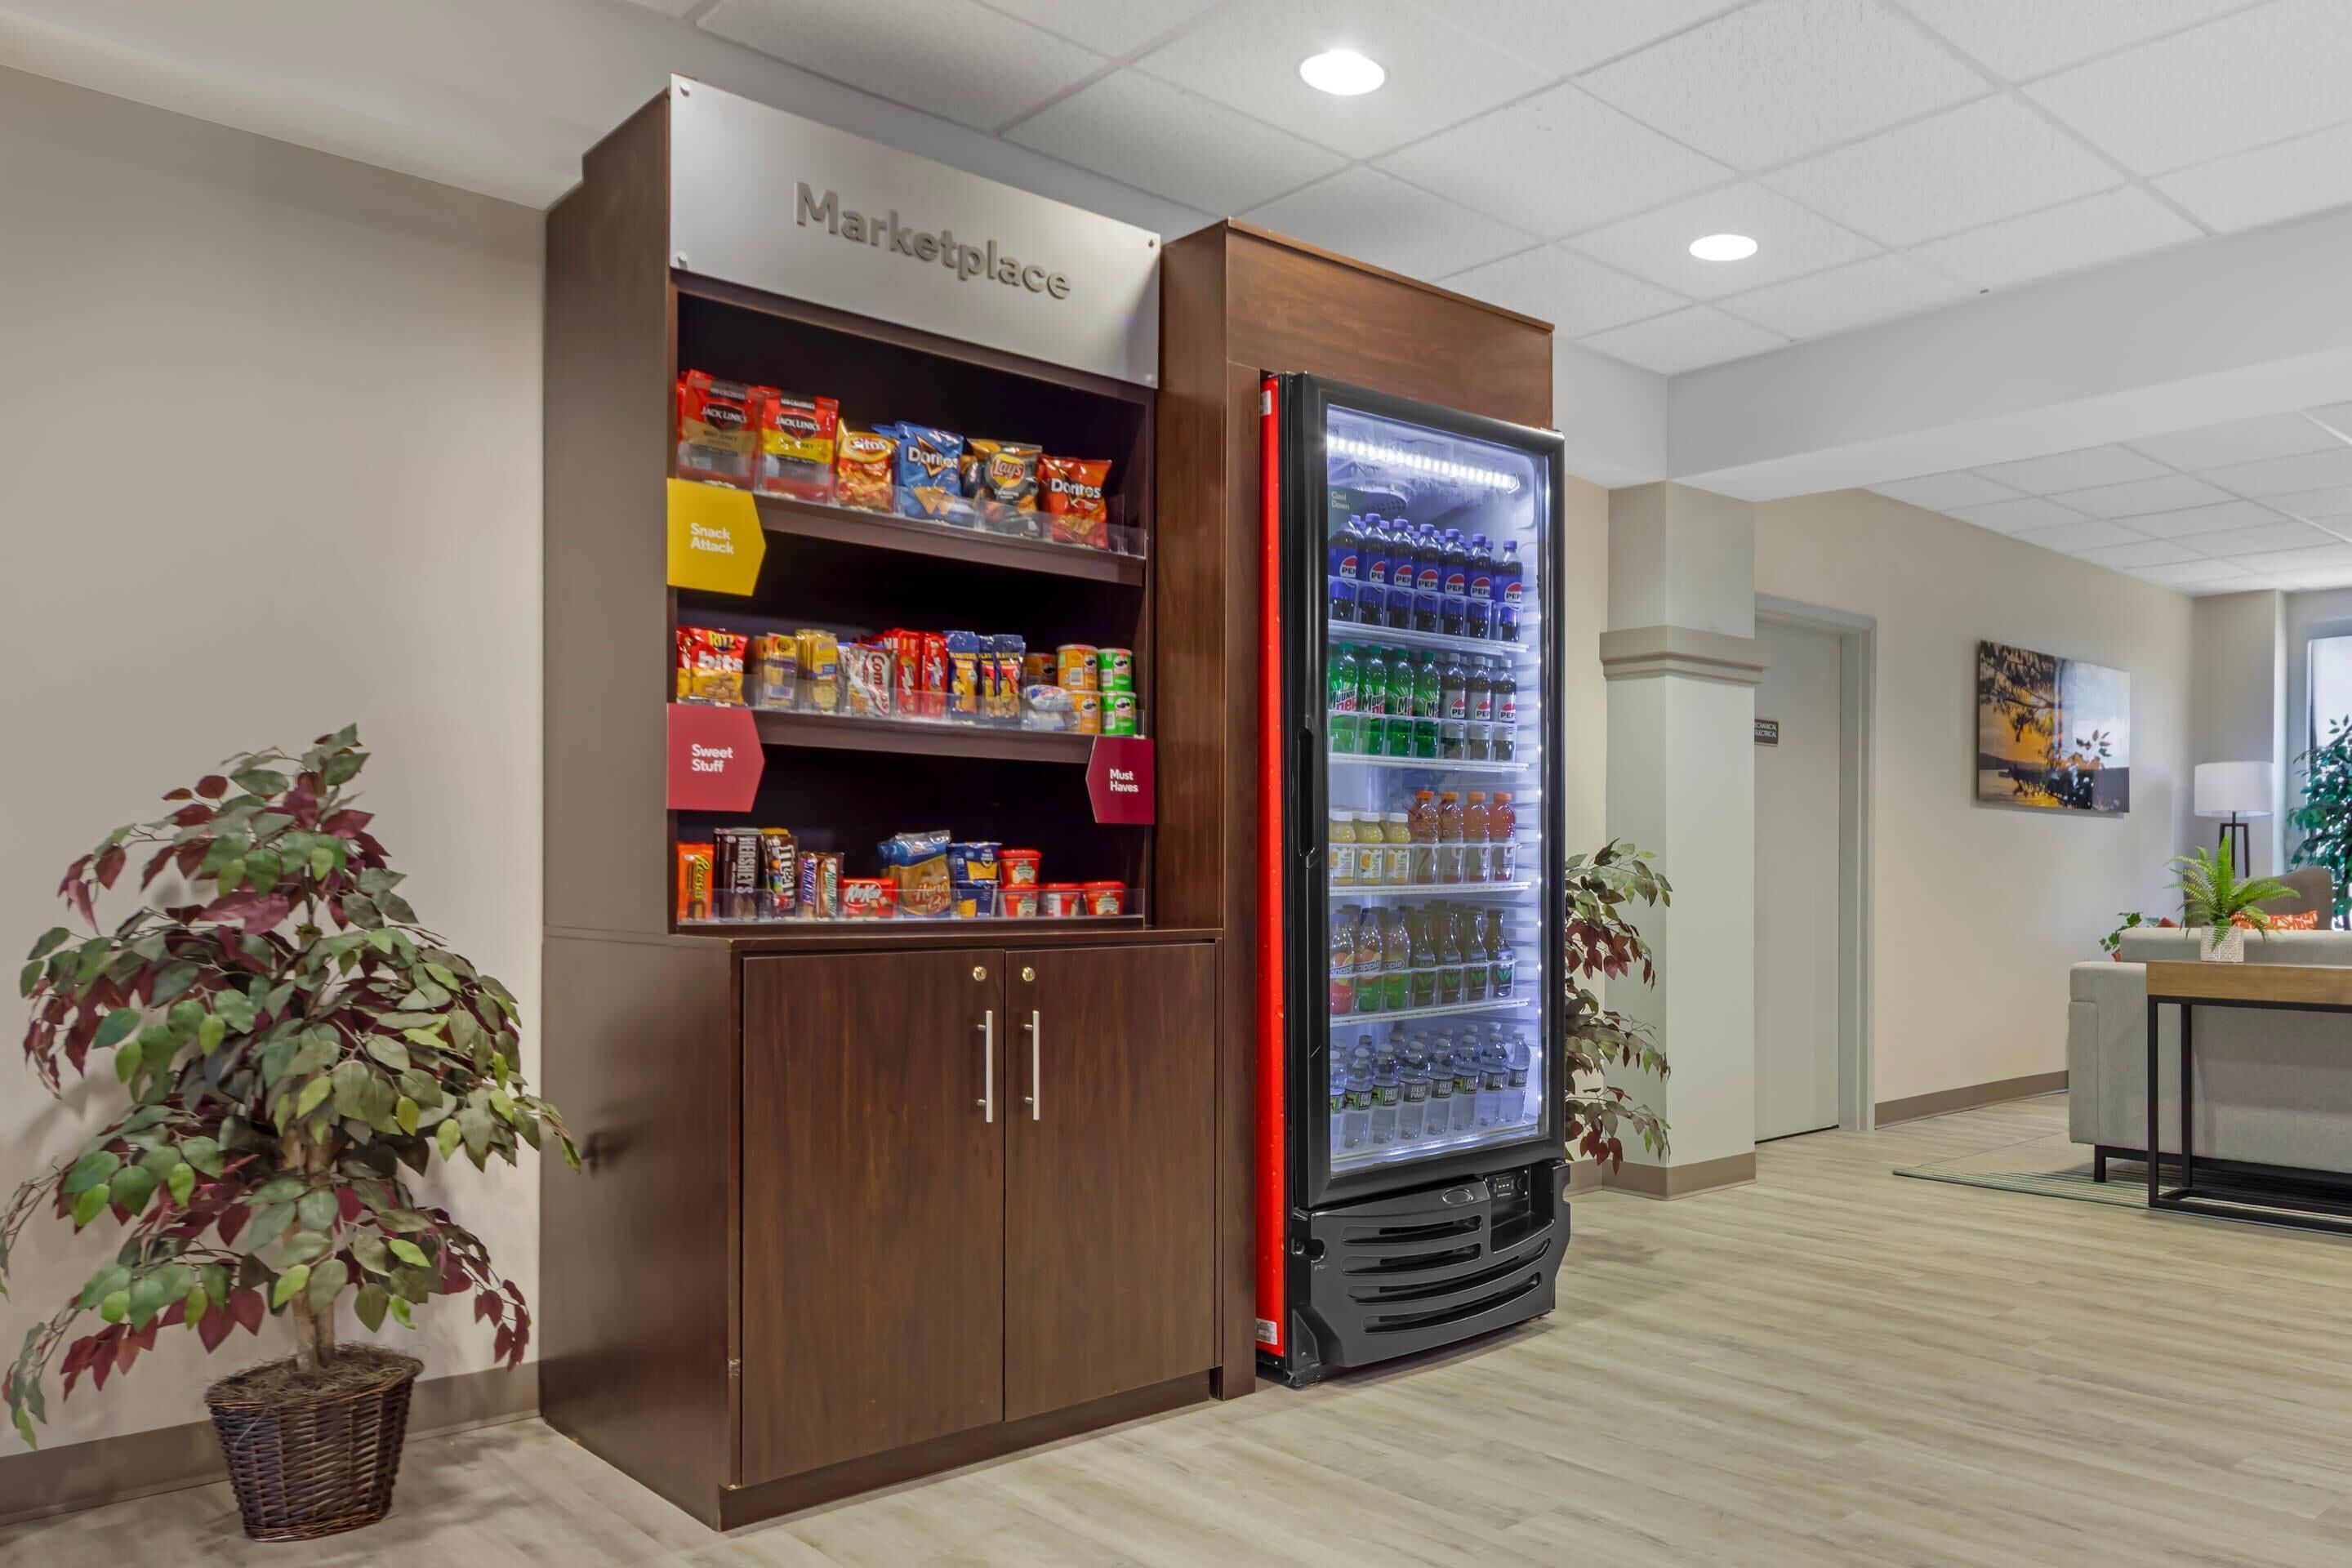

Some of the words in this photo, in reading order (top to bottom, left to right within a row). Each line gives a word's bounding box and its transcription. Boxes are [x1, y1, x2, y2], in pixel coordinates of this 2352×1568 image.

[794, 181, 1071, 301] Marketplace
[774, 416, 795, 428] JACK
[907, 445, 959, 470] Doritos
[1050, 477, 1102, 499] Doritos
[1331, 491, 1347, 501] Cool
[1331, 499, 1351, 510] Down
[690, 522, 731, 540] Snack
[690, 536, 734, 555] Attack
[711, 633, 737, 649] RITZ
[697, 650, 744, 673] bits
[692, 744, 733, 759] Sweet
[692, 758, 724, 773] Stuff
[1110, 768, 1134, 781] Must
[1110, 780, 1138, 792] Haves
[803, 859, 817, 904] SNICKERS
